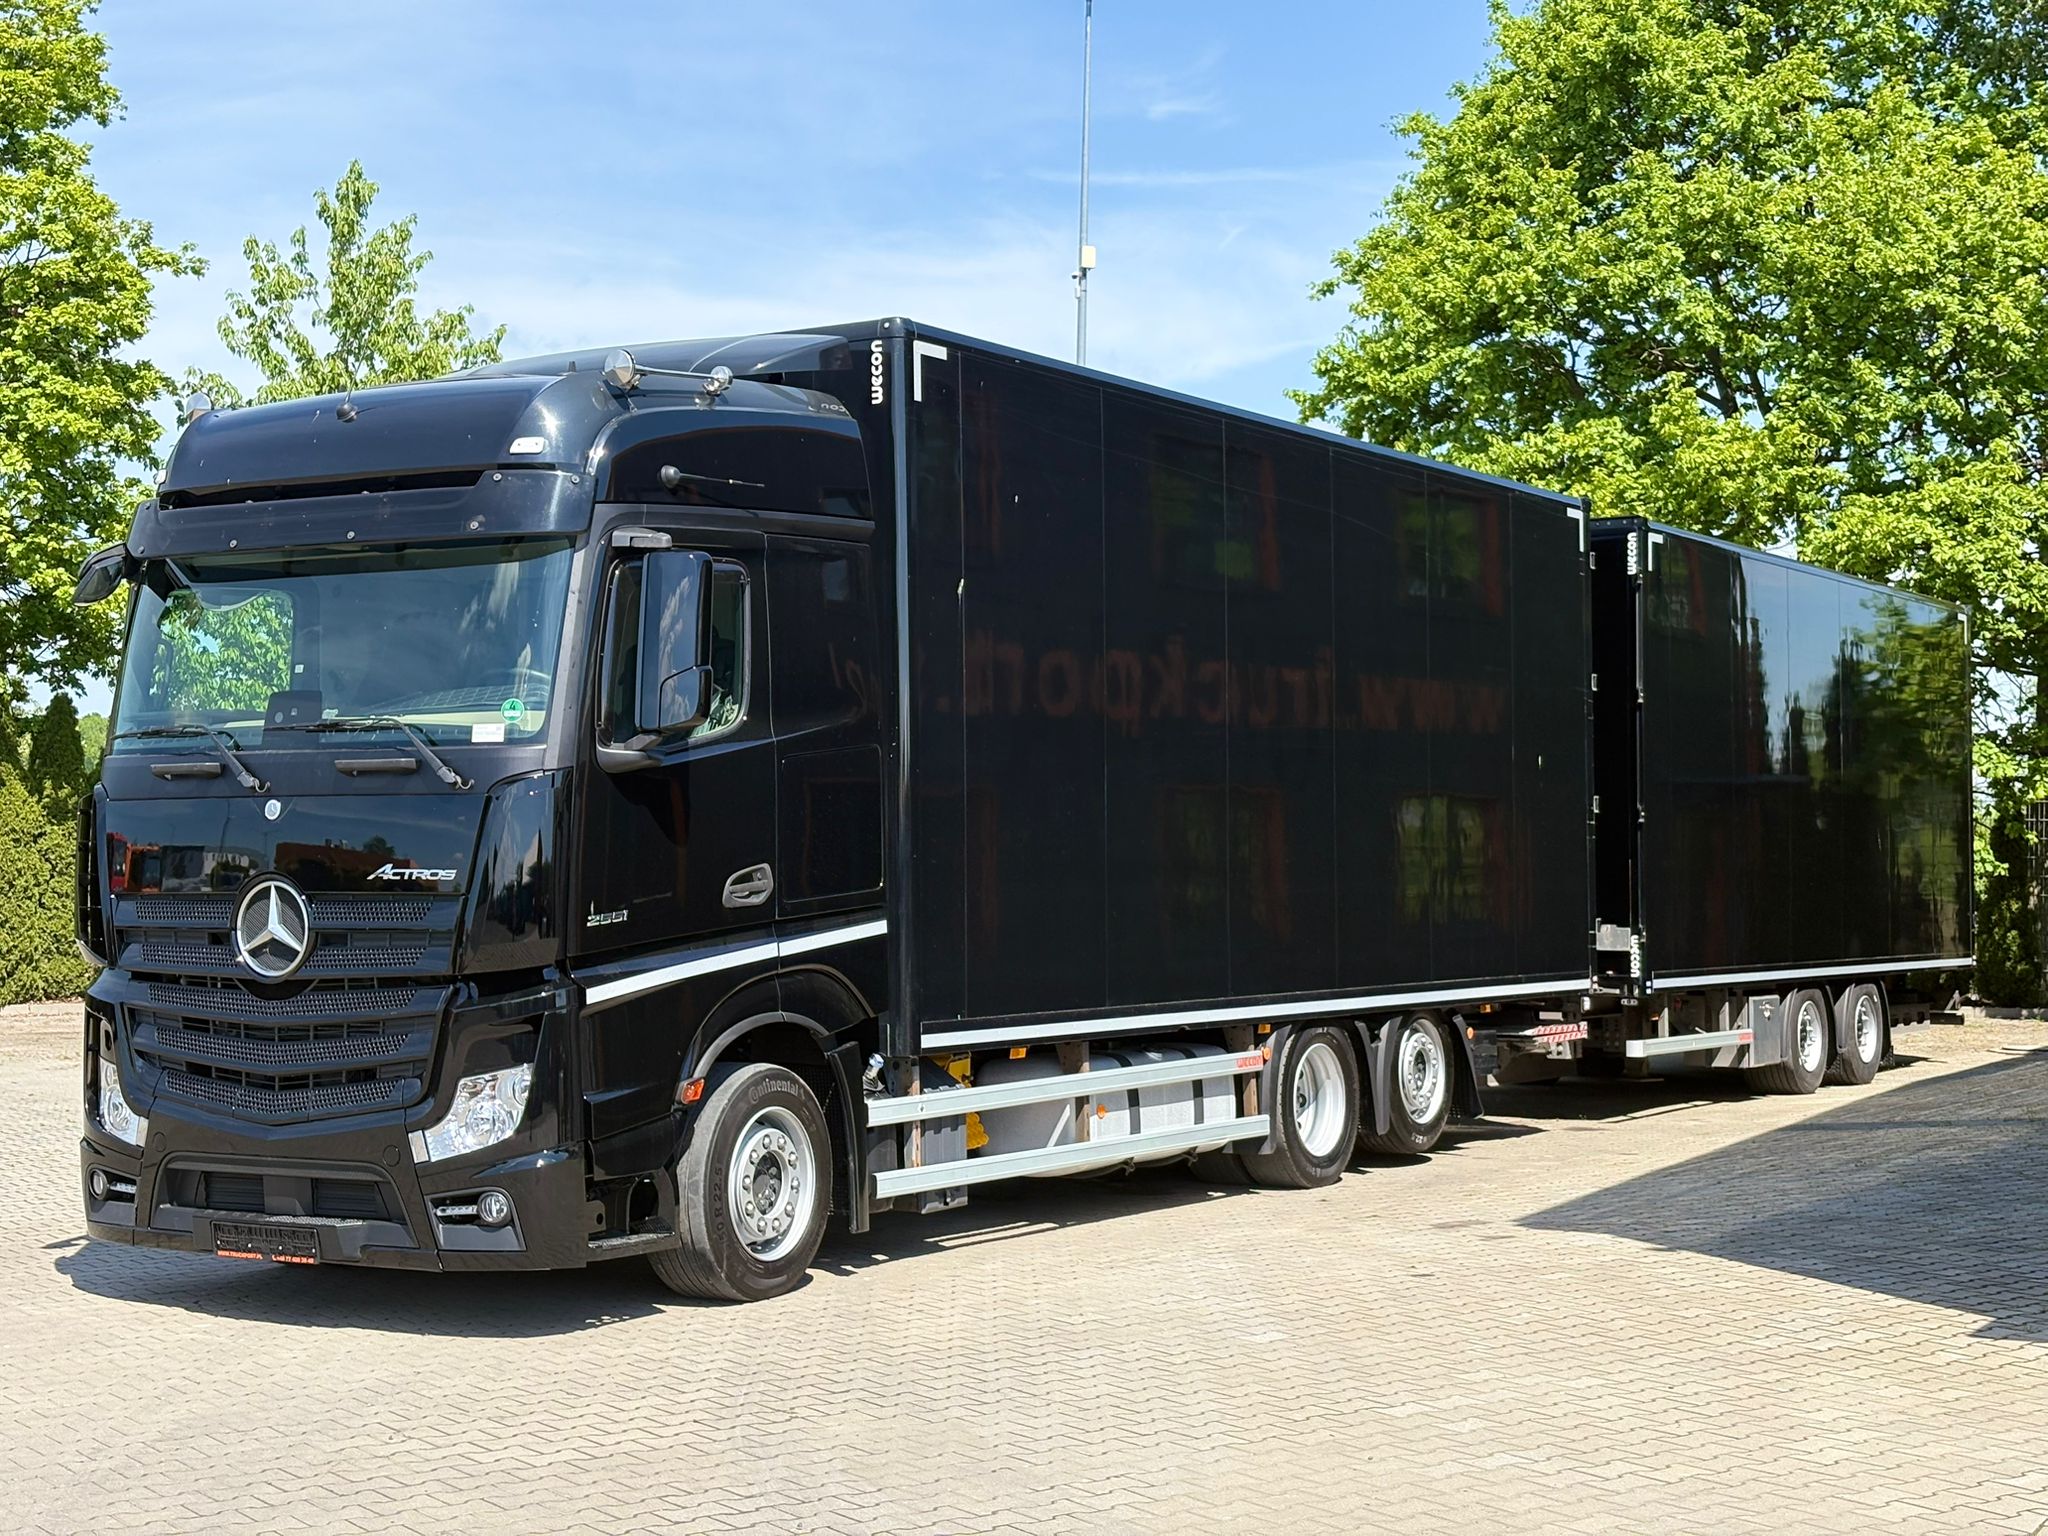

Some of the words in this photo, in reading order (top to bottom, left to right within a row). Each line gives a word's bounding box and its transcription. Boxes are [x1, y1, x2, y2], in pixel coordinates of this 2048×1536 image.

[870, 339, 884, 405] wecon
[1627, 532, 1637, 575] wecon
[366, 863, 458, 880] ACTROS
[1630, 934, 1640, 978] wecon
[749, 1078, 798, 1104] Continental
[712, 1166, 723, 1202] 22.5
